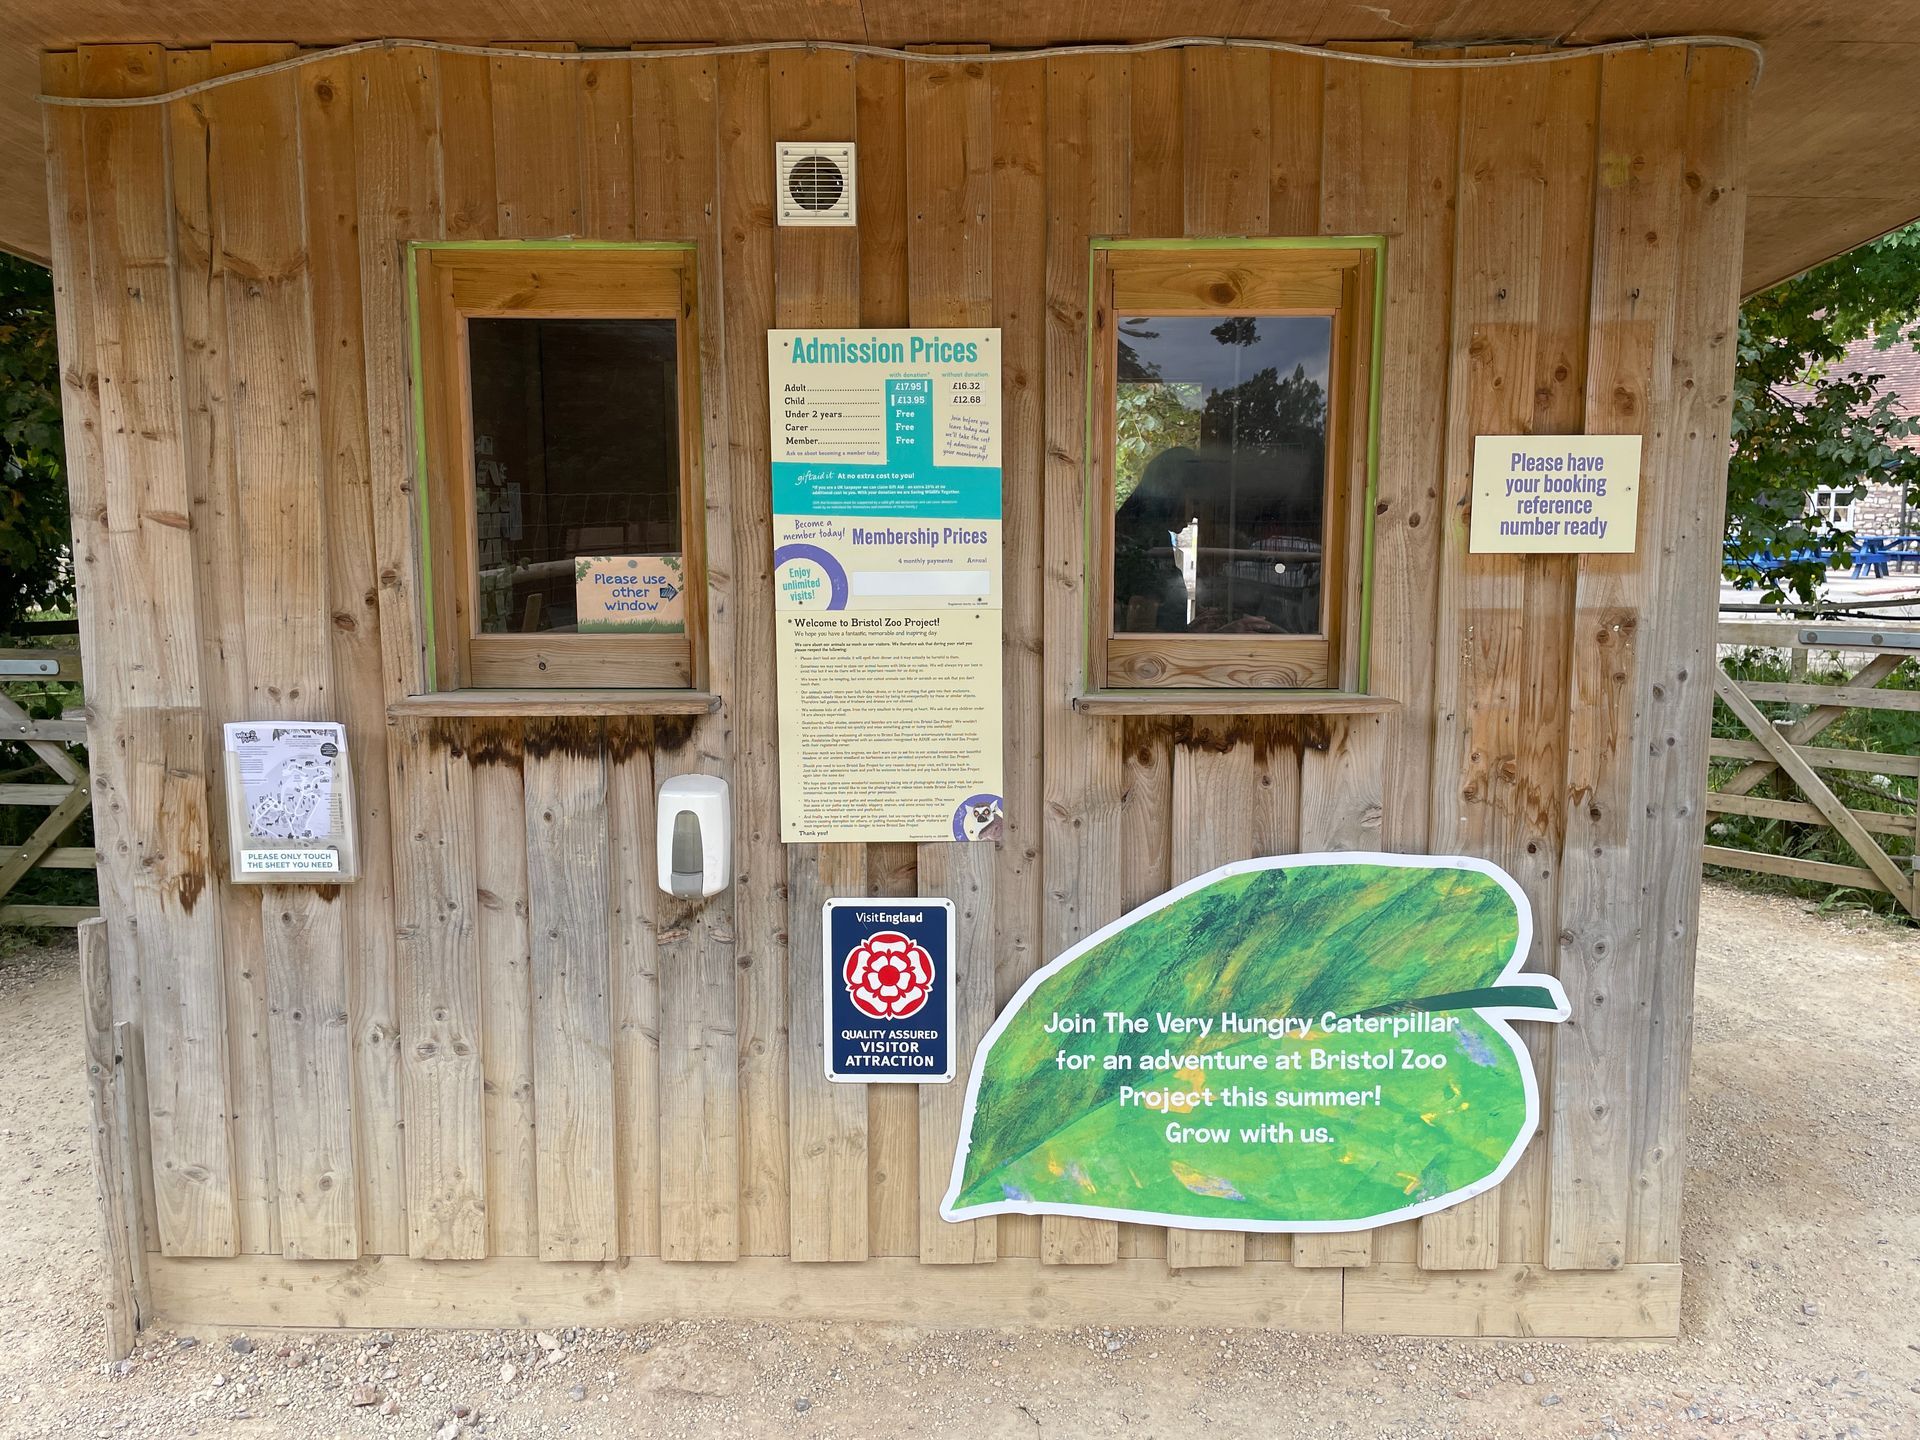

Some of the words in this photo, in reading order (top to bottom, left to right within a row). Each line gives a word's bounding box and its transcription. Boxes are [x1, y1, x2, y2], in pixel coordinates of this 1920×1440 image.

[792, 336, 904, 364] Admission
[910, 336, 978, 363] Prices
[784, 384, 806, 392] Adult
[895, 382, 922, 391] £17.95
[952, 382, 980, 390] £16.32
[784, 397, 805, 405] Child
[897, 396, 925, 404] £13.95
[952, 396, 981, 404] £12.68
[785, 410, 810, 418] Under
[812, 410, 818, 418] 2
[820, 412, 842, 420] years
[963, 416, 978, 424] before
[895, 423, 915, 431] Free
[963, 425, 977, 434] today
[785, 437, 818, 445] Member
[954, 441, 978, 449] admission
[1511, 453, 1563, 471] Please
[1567, 453, 1604, 471] have
[900, 472, 915, 480] you!
[1505, 478, 1540, 497] your
[1544, 474, 1607, 496] booking
[1517, 496, 1593, 514] reference
[795, 520, 824, 530] Become
[1500, 517, 1561, 536] number
[1564, 517, 1608, 539] ready
[783, 530, 816, 540] member
[819, 528, 845, 540] today!
[852, 528, 939, 548] Membership
[943, 528, 988, 545] Prices
[594, 574, 638, 584] Please
[643, 576, 666, 584] use
[789, 568, 811, 579] Enjoy
[782, 578, 821, 591] unlimited
[612, 587, 650, 598] other
[790, 590, 815, 601] visits!
[604, 600, 659, 611] window
[794, 618, 837, 628] Welcome
[839, 619, 849, 627] to
[851, 618, 882, 627] Bristol
[885, 618, 902, 627] Zoo
[904, 617, 940, 629] Project!
[856, 912, 923, 925] VisitEngland
[1044, 1012, 1096, 1034] Join
[1103, 1012, 1149, 1033] The
[1156, 1012, 1213, 1039] Very
[1221, 1012, 1313, 1040] Hungry
[1320, 1011, 1460, 1038] Caterpillar
[841, 1030, 886, 1040] QUALITY
[889, 1030, 938, 1039] ASSURED
[861, 1042, 919, 1053] VISITOR
[845, 1055, 934, 1067] ATTRACTION
[1055, 1050, 1095, 1070] for
[1103, 1054, 1132, 1070] an
[1139, 1049, 1268, 1070] adventure
[1275, 1052, 1302, 1070] at
[1310, 1049, 1394, 1070] Bristol
[1401, 1049, 1447, 1069] Zoo
[1120, 1086, 1213, 1114] Project
[1221, 1086, 1268, 1107] this
[1275, 1085, 1381, 1106] summer!
[1166, 1121, 1231, 1144] Grow
[1240, 1123, 1293, 1143] with
[1300, 1126, 1334, 1143] us.
